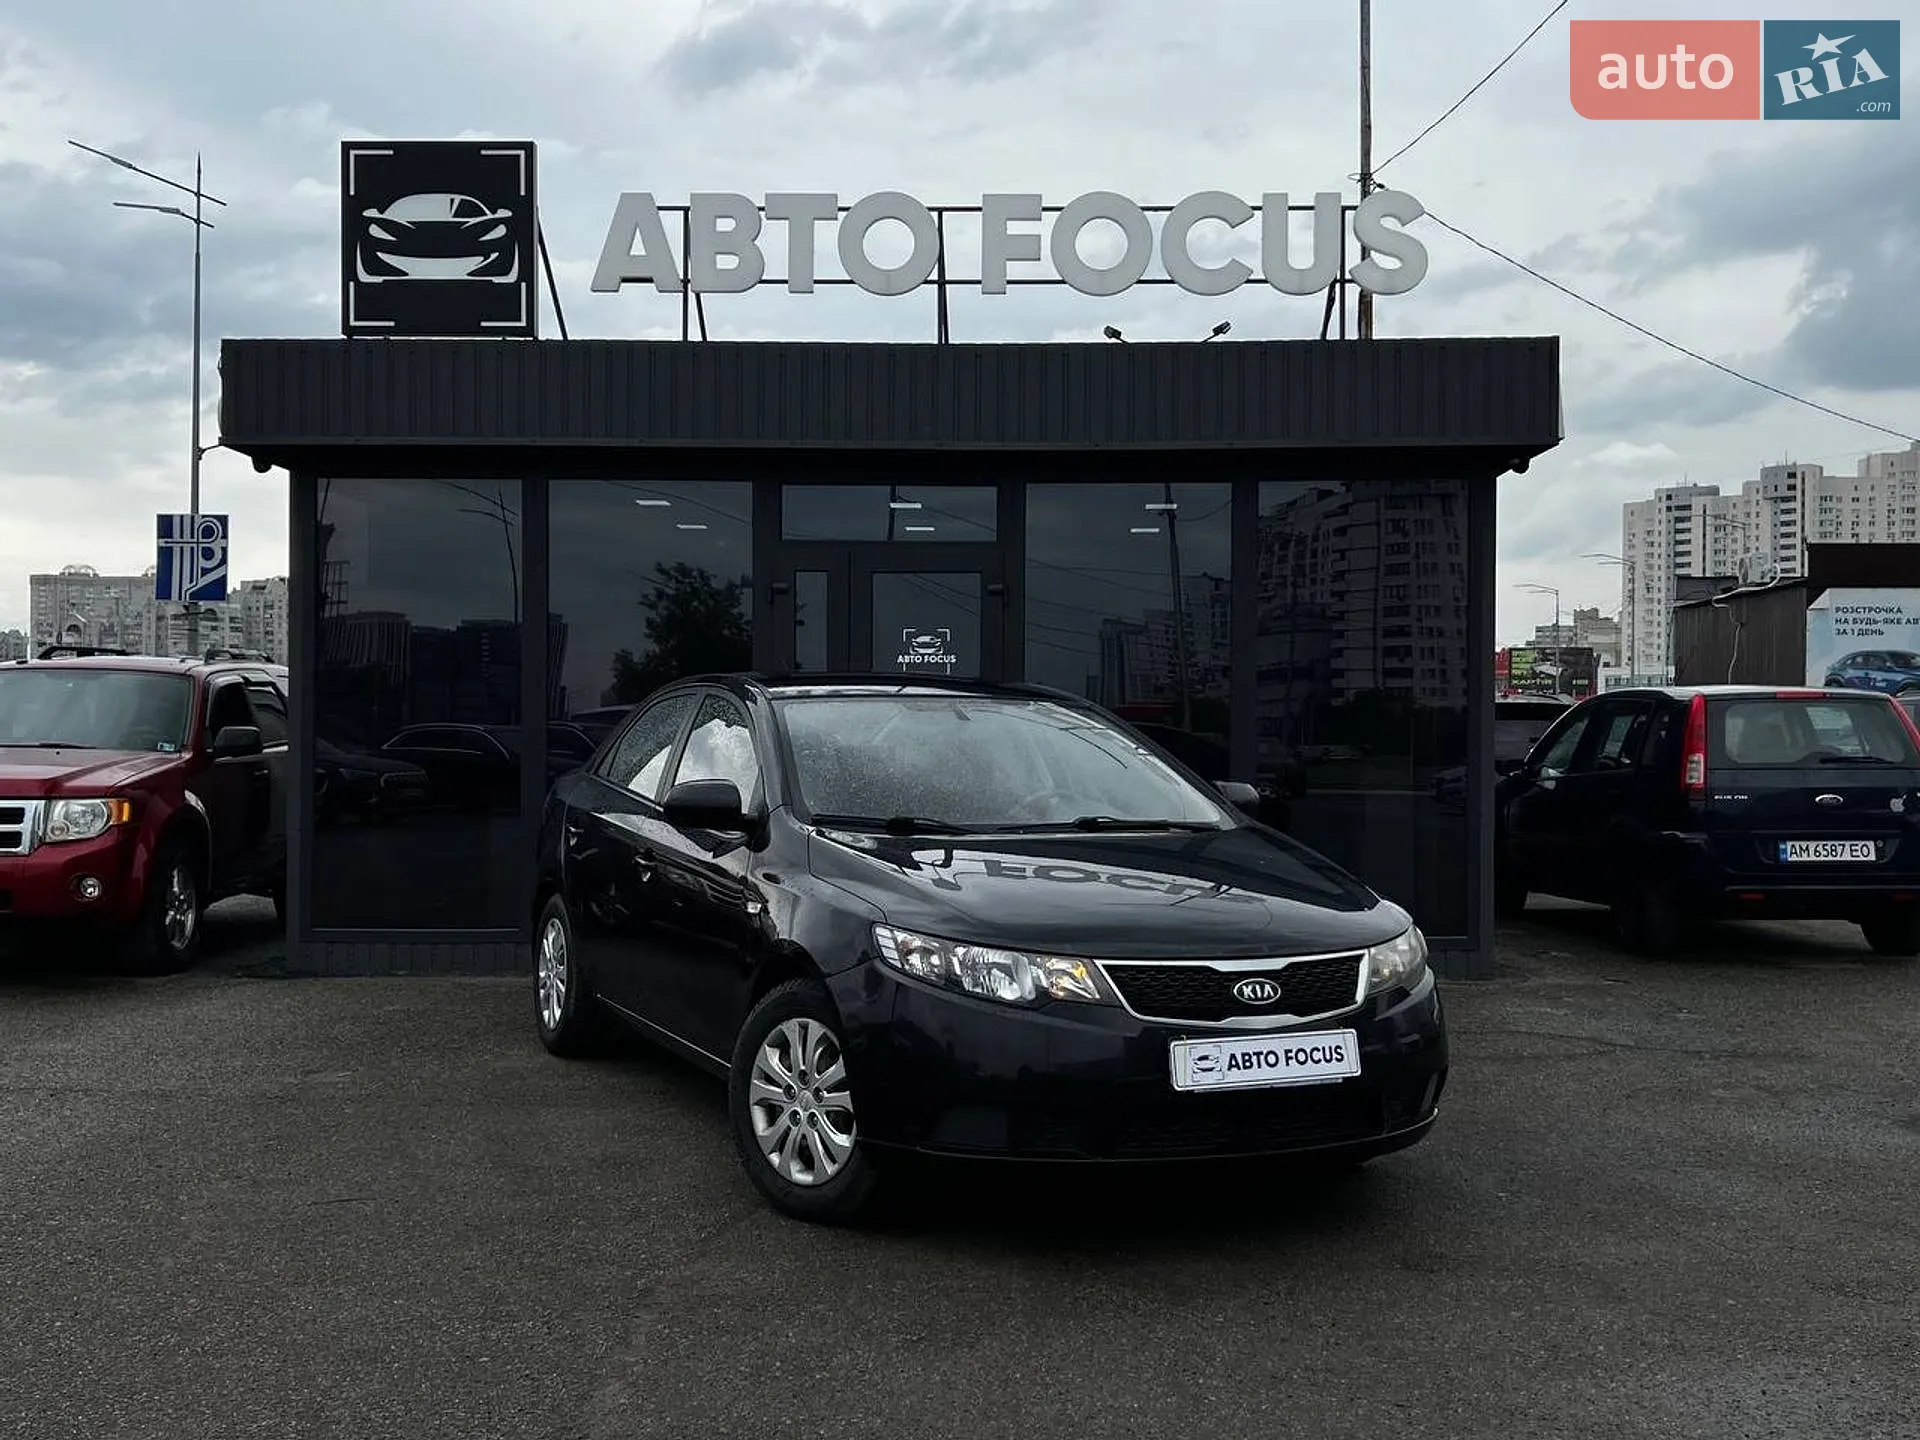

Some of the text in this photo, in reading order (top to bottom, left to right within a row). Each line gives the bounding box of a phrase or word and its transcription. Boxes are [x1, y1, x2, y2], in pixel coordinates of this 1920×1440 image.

[590, 191, 1429, 296] АВТО FOCUS
[1835, 606, 1903, 614] РОЗСТРОЧКА
[1835, 617, 1850, 625] НА
[1905, 617, 1920, 625] АВ
[1835, 628, 1848, 636] ЗА
[1857, 628, 1885, 637] ДЕНЬ
[897, 654, 957, 663] АВТО FOCUS
[1790, 844, 1810, 858] AM
[1813, 843, 1846, 858] 6587
[1849, 843, 1870, 858] EO
[1242, 984, 1275, 999] KIA
[1227, 1045, 1345, 1071] АВТО FOCUS
